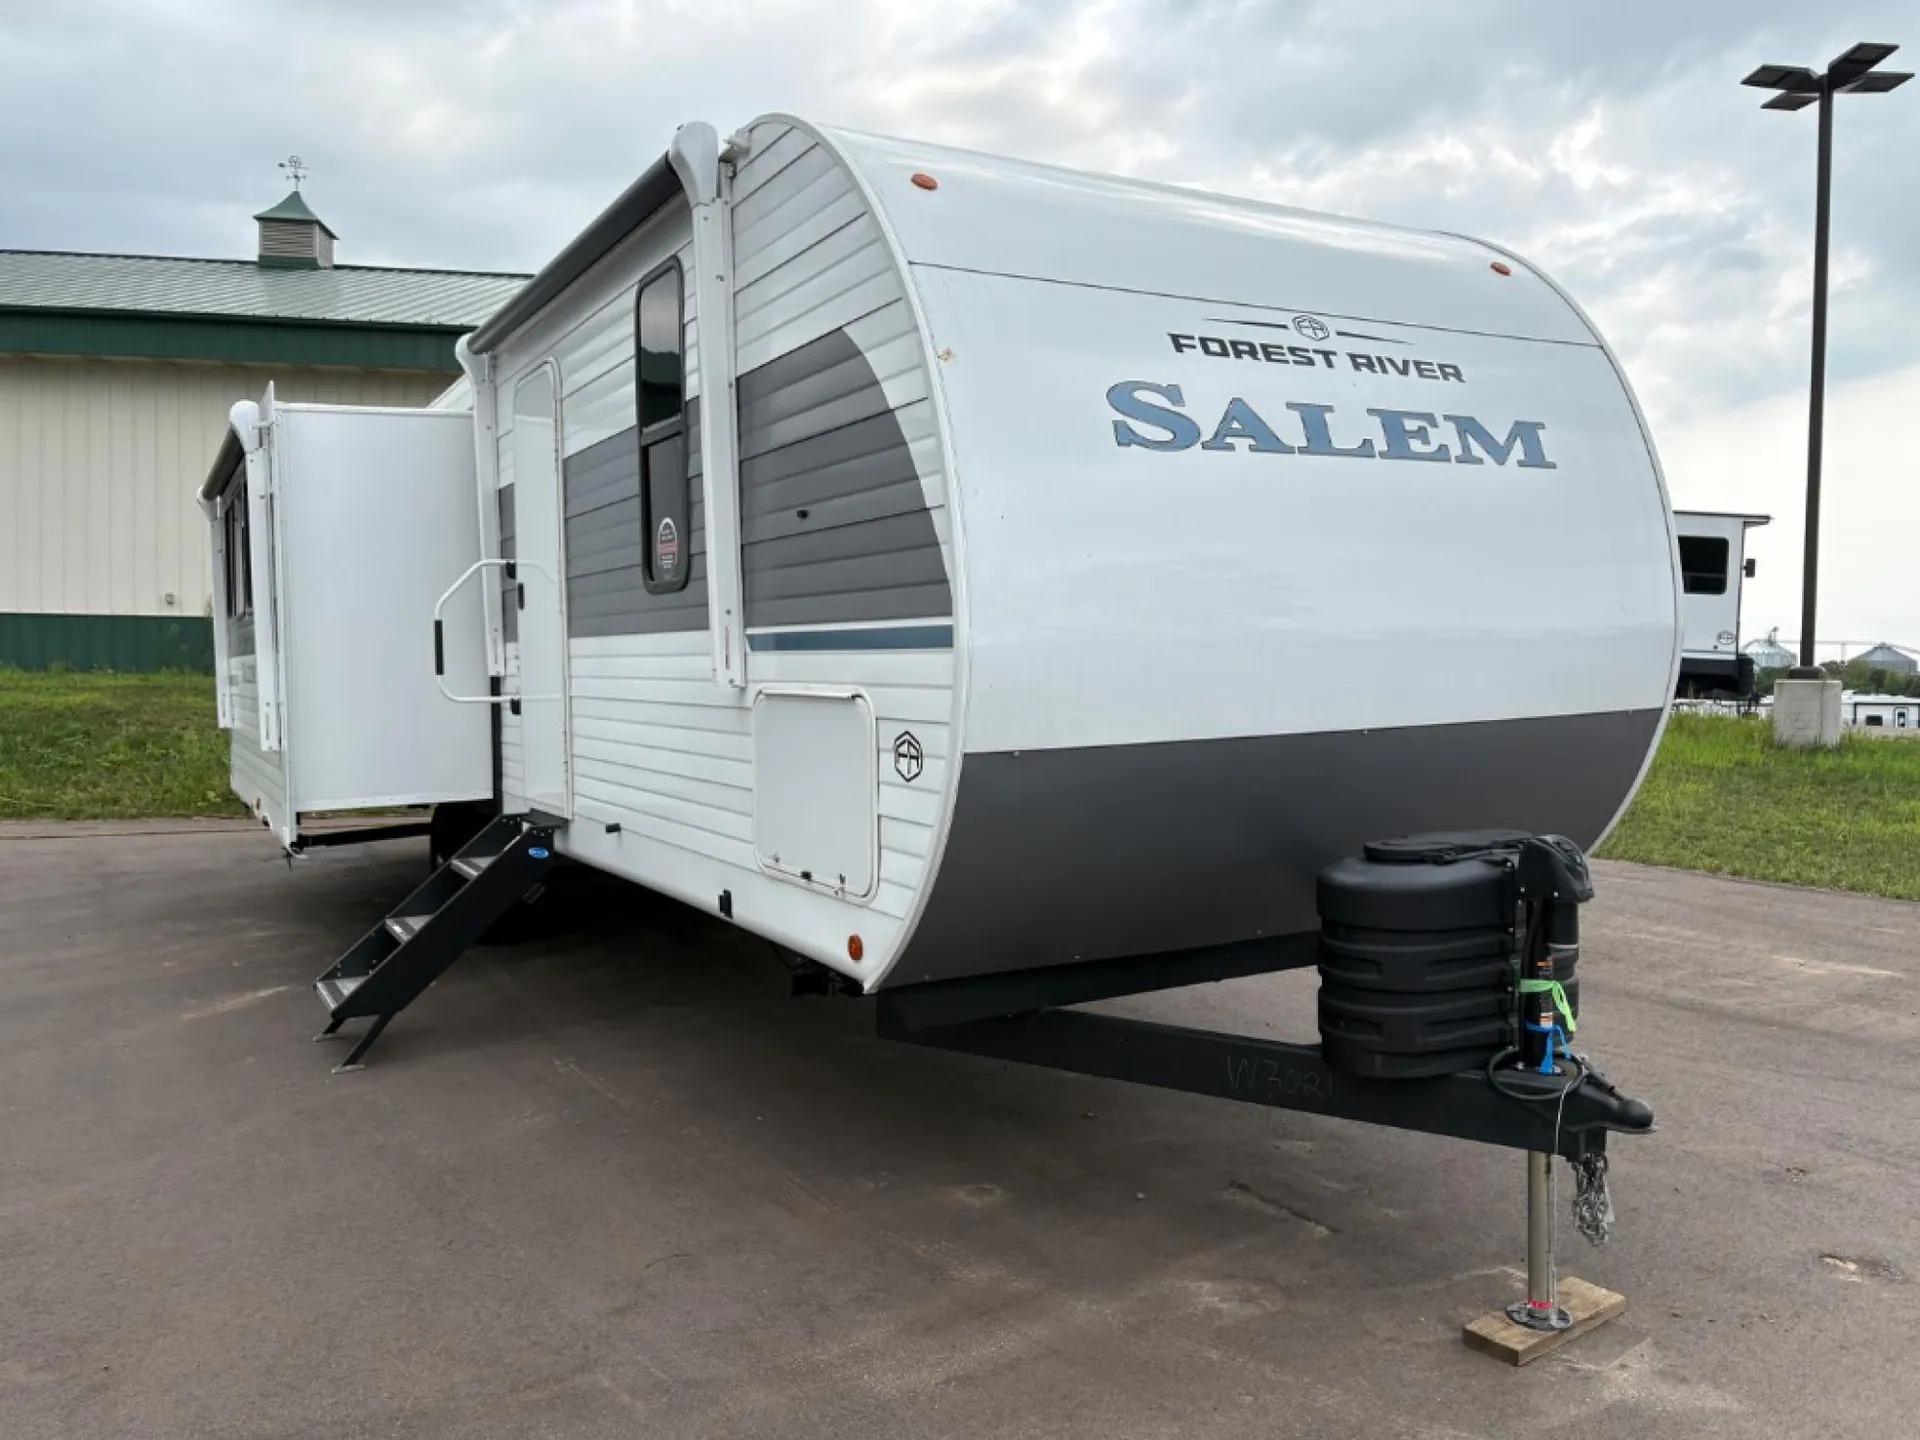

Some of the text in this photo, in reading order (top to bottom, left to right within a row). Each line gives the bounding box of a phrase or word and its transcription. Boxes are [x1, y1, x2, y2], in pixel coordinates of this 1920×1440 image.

[1168, 333, 1466, 383] FOREST RIVER
[1106, 381, 1557, 469] SALEM
